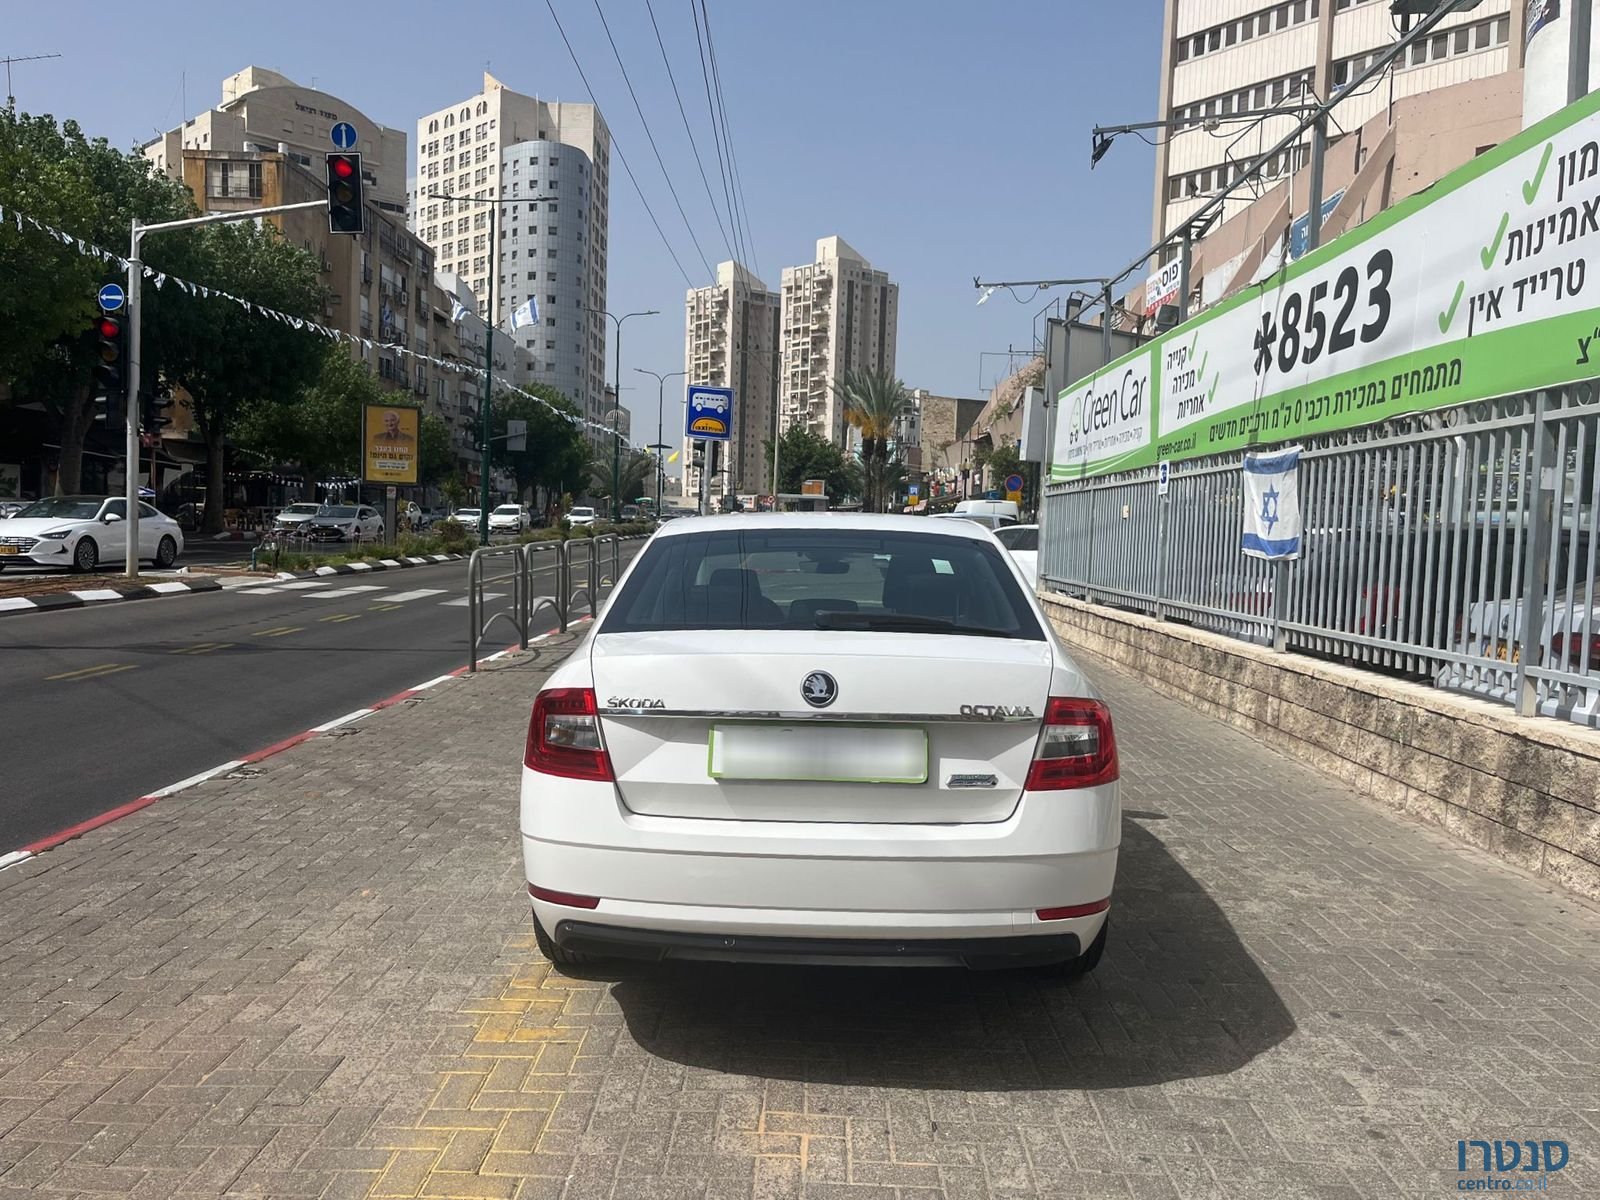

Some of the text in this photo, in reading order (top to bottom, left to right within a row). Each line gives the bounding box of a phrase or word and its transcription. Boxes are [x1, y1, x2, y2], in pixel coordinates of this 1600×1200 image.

[1504, 194, 1600, 266] אמינות
[1162, 260, 1182, 287] פוס
[1467, 258, 1586, 338] טרייד אין
[1166, 346, 1187, 371] קנייה
[1172, 369, 1196, 395] מכירה
[1390, 358, 1462, 401] מתמחים
[1082, 368, 1147, 436] Green Car
[1177, 393, 1205, 420] אחריות
[1304, 395, 1330, 422] רכבי
[1332, 379, 1387, 415] במכירת
[1294, 398, 1303, 424] 0
[1208, 419, 1238, 443] חדשים
[1156, 432, 1197, 461] green-car.co.il
[960, 704, 1035, 718] OCTAVIA
